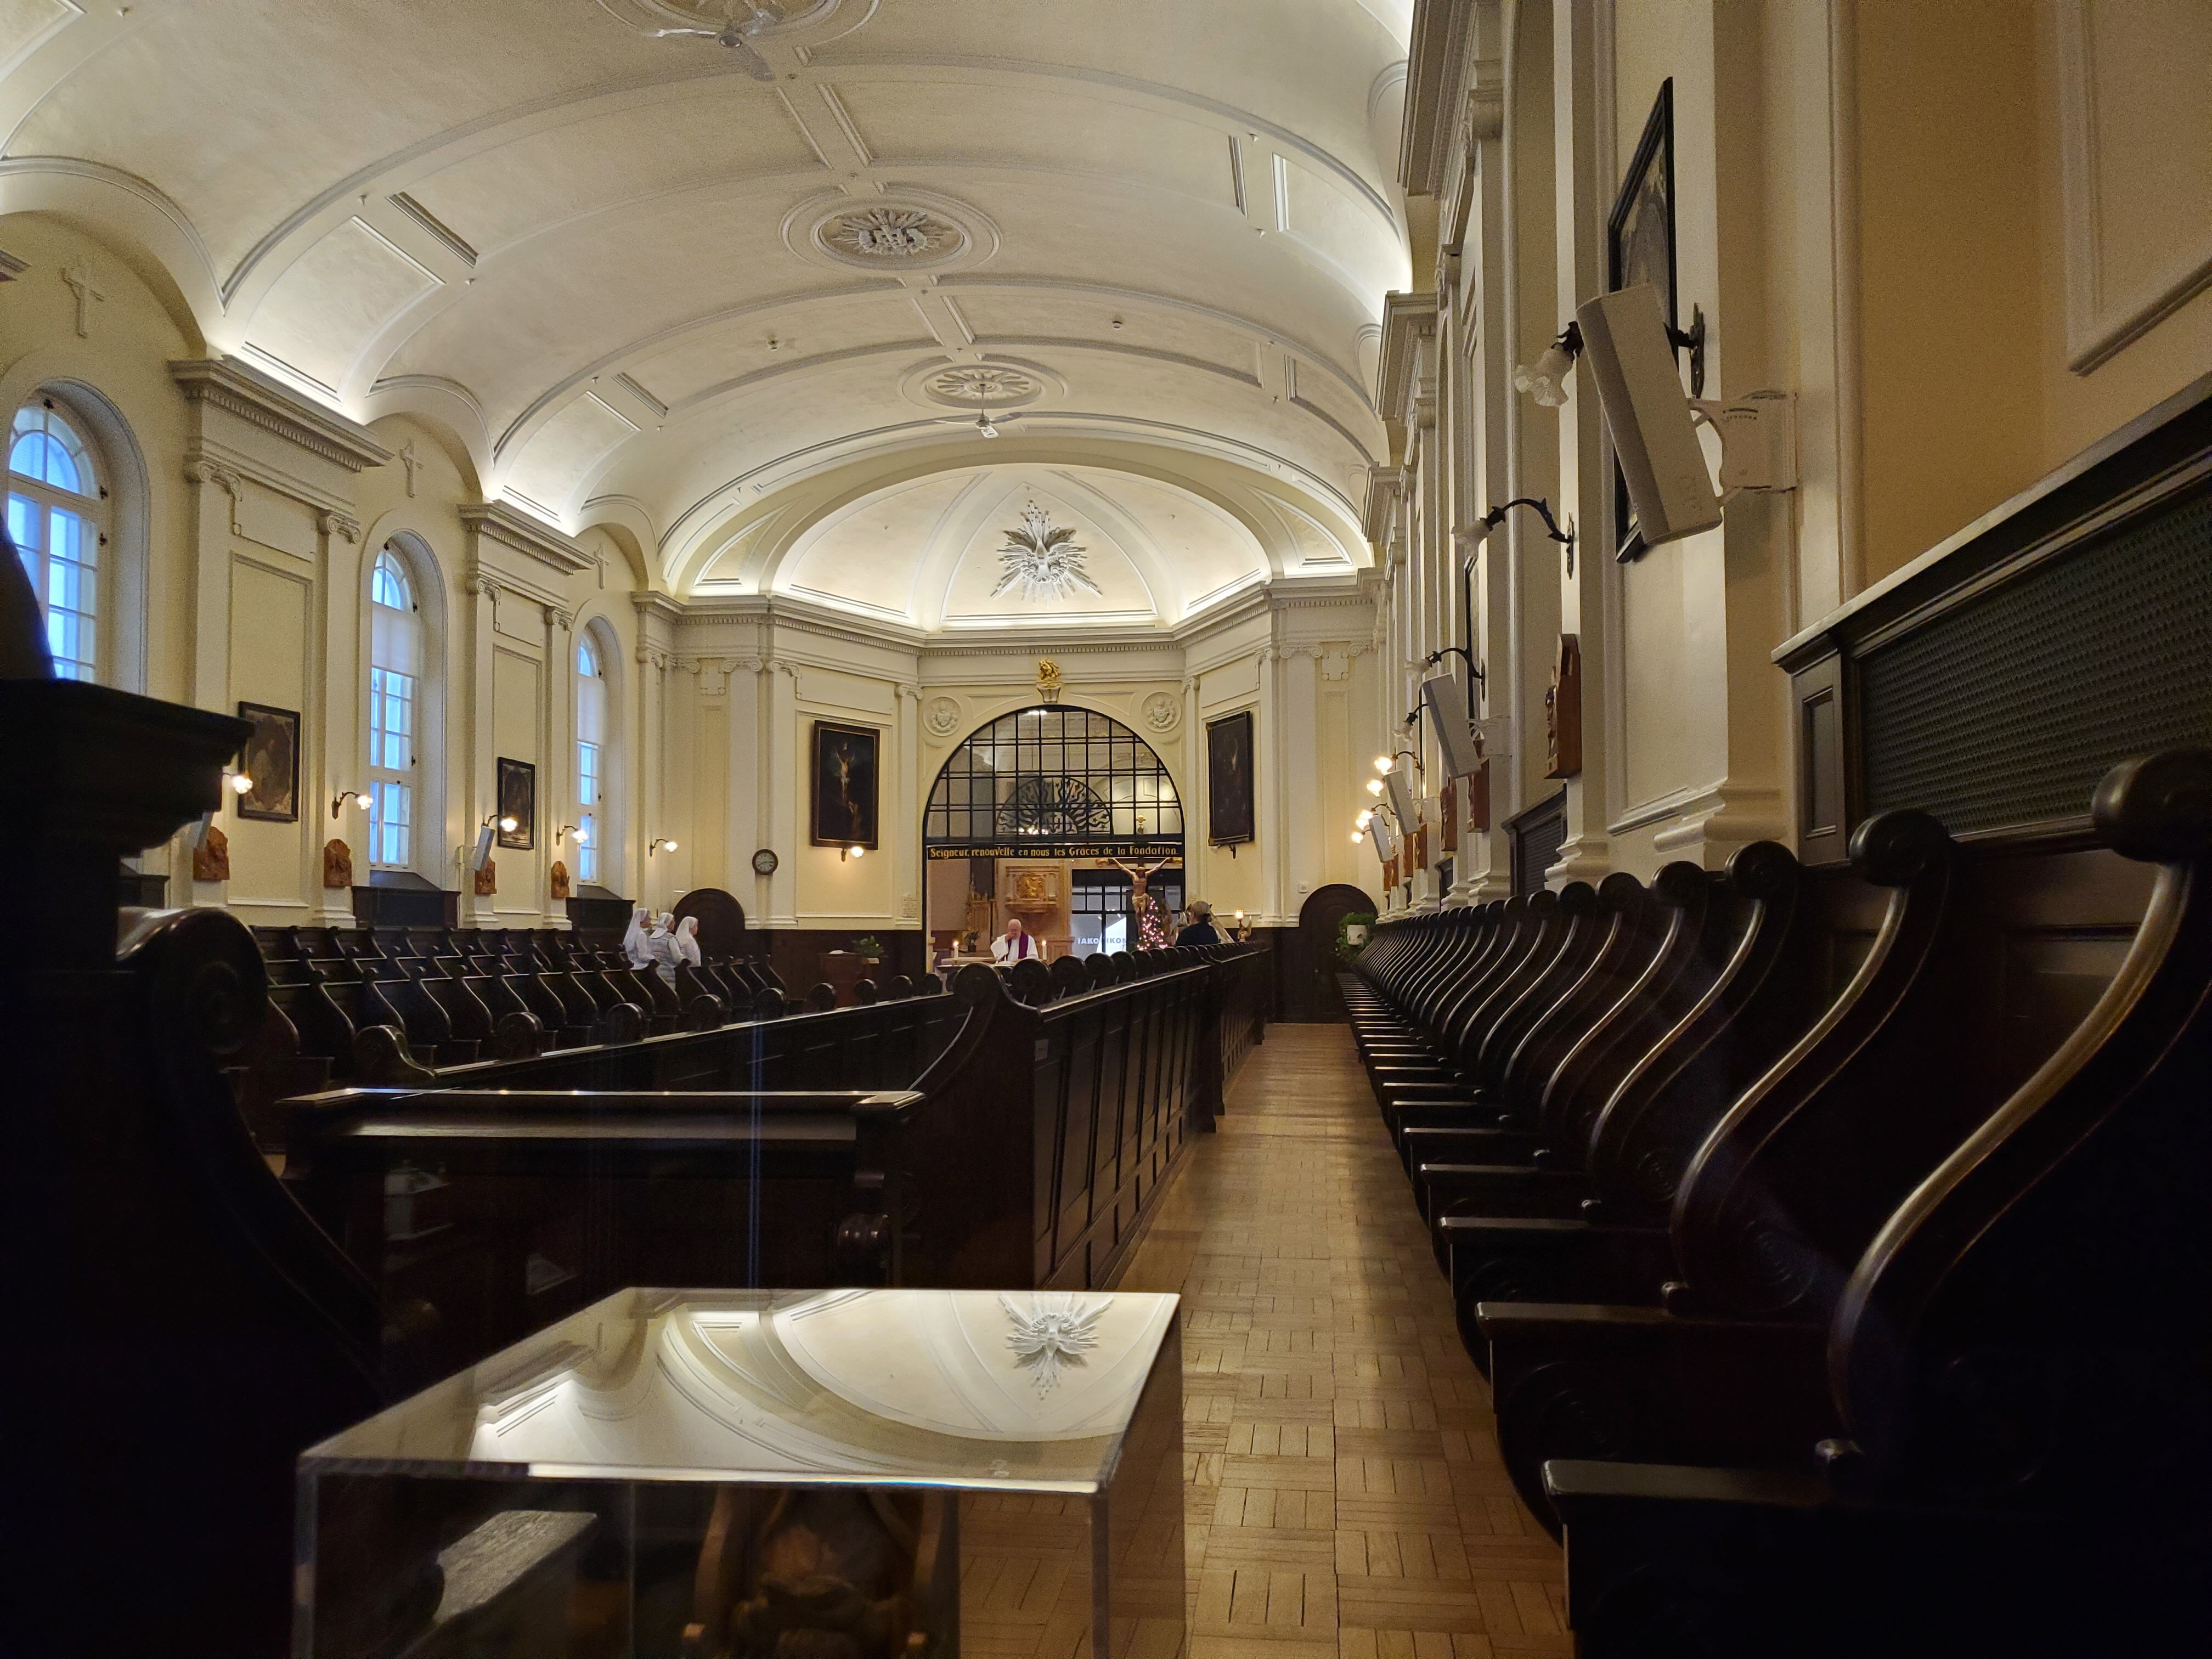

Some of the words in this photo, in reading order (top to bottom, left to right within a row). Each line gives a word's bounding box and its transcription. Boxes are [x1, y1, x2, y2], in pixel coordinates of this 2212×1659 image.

[1054, 847, 1065, 856] les
[1103, 847, 1113, 855] de
[1118, 847, 1126, 855] la
